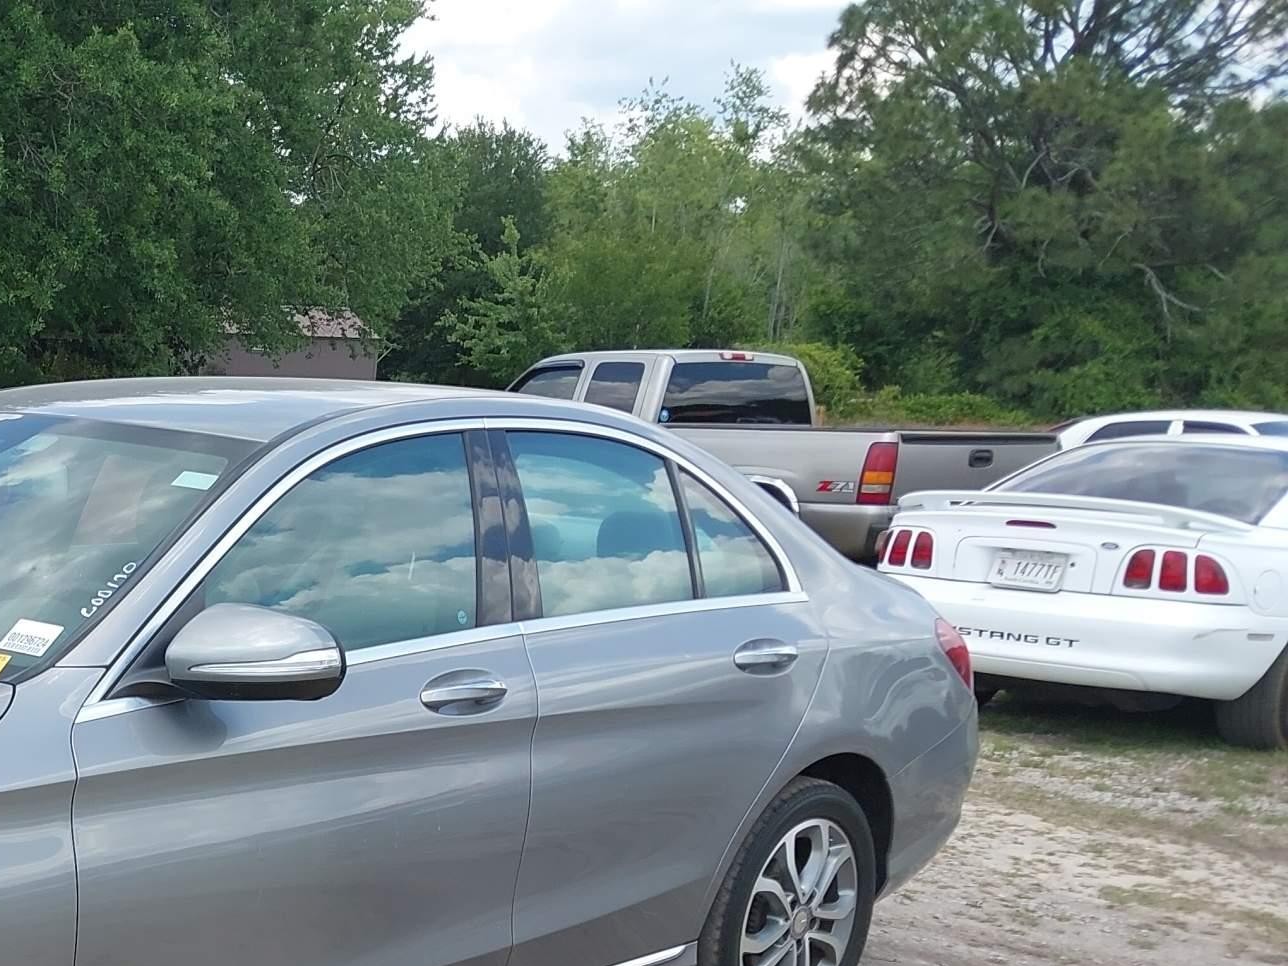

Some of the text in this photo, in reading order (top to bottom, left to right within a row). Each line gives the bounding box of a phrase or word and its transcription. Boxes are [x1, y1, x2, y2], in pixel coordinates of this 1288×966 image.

[816, 480, 854, 493] Z71
[952, 625, 1080, 648] STANG GT
